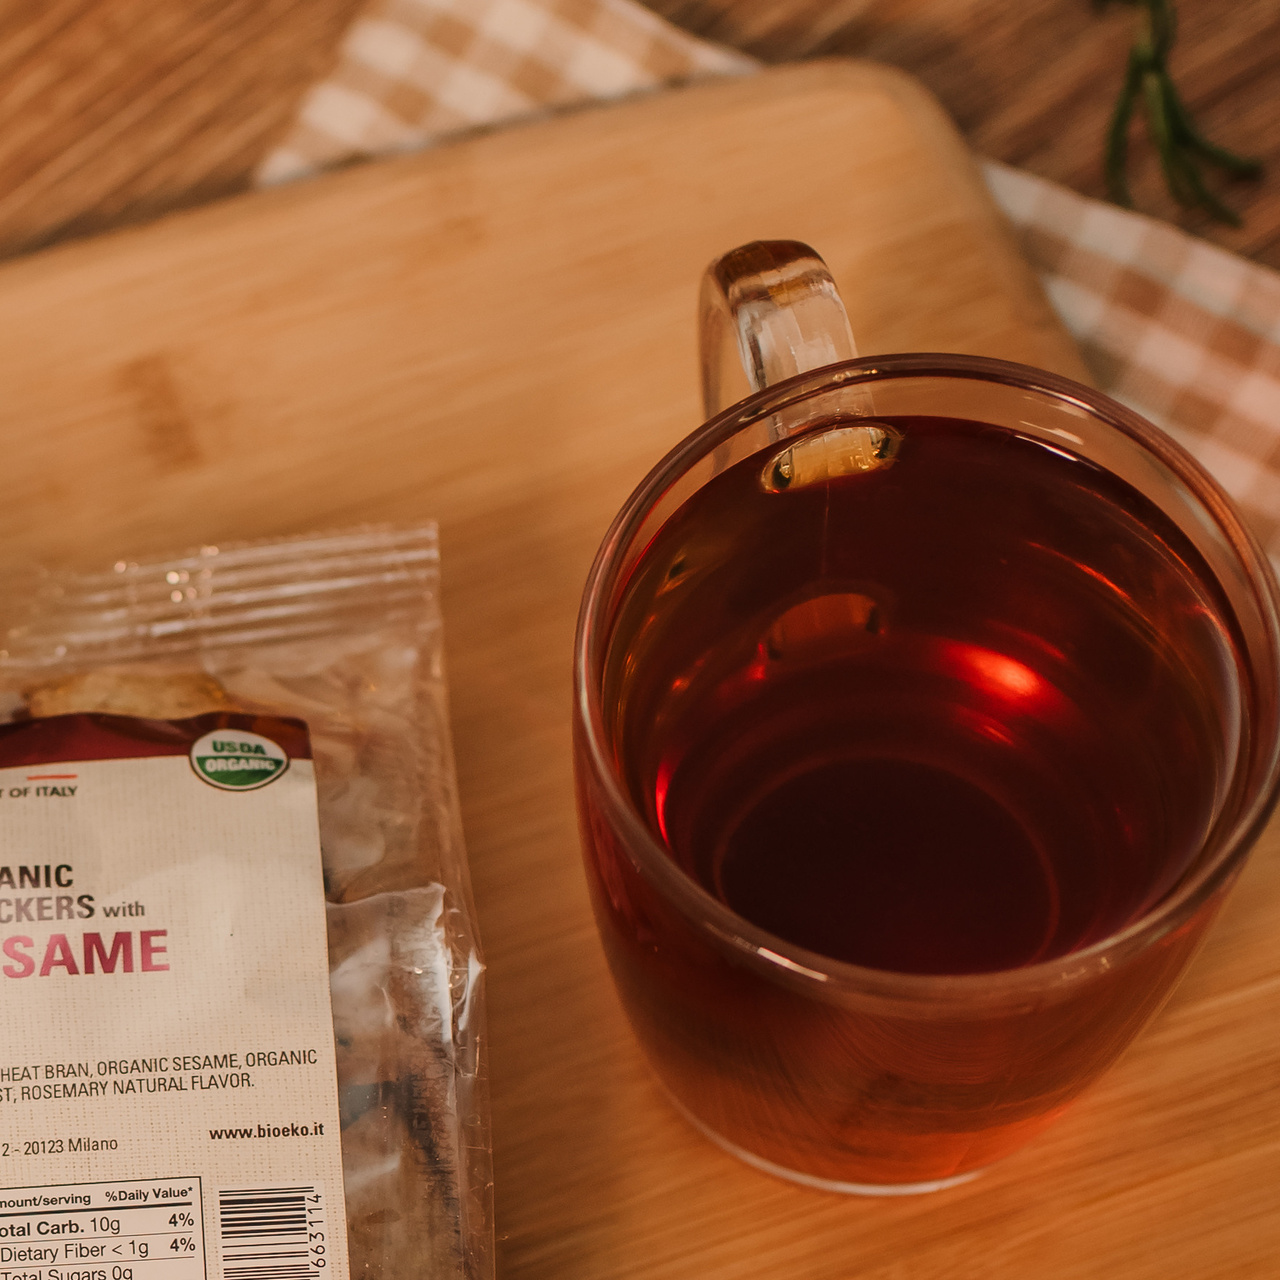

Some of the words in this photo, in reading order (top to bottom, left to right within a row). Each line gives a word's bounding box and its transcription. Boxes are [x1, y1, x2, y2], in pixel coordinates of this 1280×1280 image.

[212, 740, 266, 755] USDA
[205, 758, 275, 772] ORGANIC
[9, 786, 31, 799] OF
[36, 785, 78, 798] ITALY
[102, 901, 145, 918] with
[45, 1062, 93, 1079] BRAN,
[97, 1057, 168, 1076] ORGANIC
[172, 1053, 242, 1071] SESAME,
[246, 1049, 317, 1067] ORGANIC
[21, 1081, 108, 1101] ROSEMARY
[113, 1077, 188, 1095] NATURAL
[191, 1073, 254, 1090] FLAVOR.
[210, 1122, 324, 1139] www.bioeko.it
[24, 1139, 64, 1155] 20123
[68, 1138, 118, 1152] Milano
[105, 1189, 149, 1203] %Daily
[36, 1219, 85, 1235] Carb.
[89, 1218, 121, 1234] 10g
[169, 1212, 194, 1228] 4%
[1, 1246, 59, 1264] Dietary
[64, 1243, 106, 1259] Fiber
[129, 1241, 149, 1258] 1g
[170, 1238, 196, 1252] 4%
